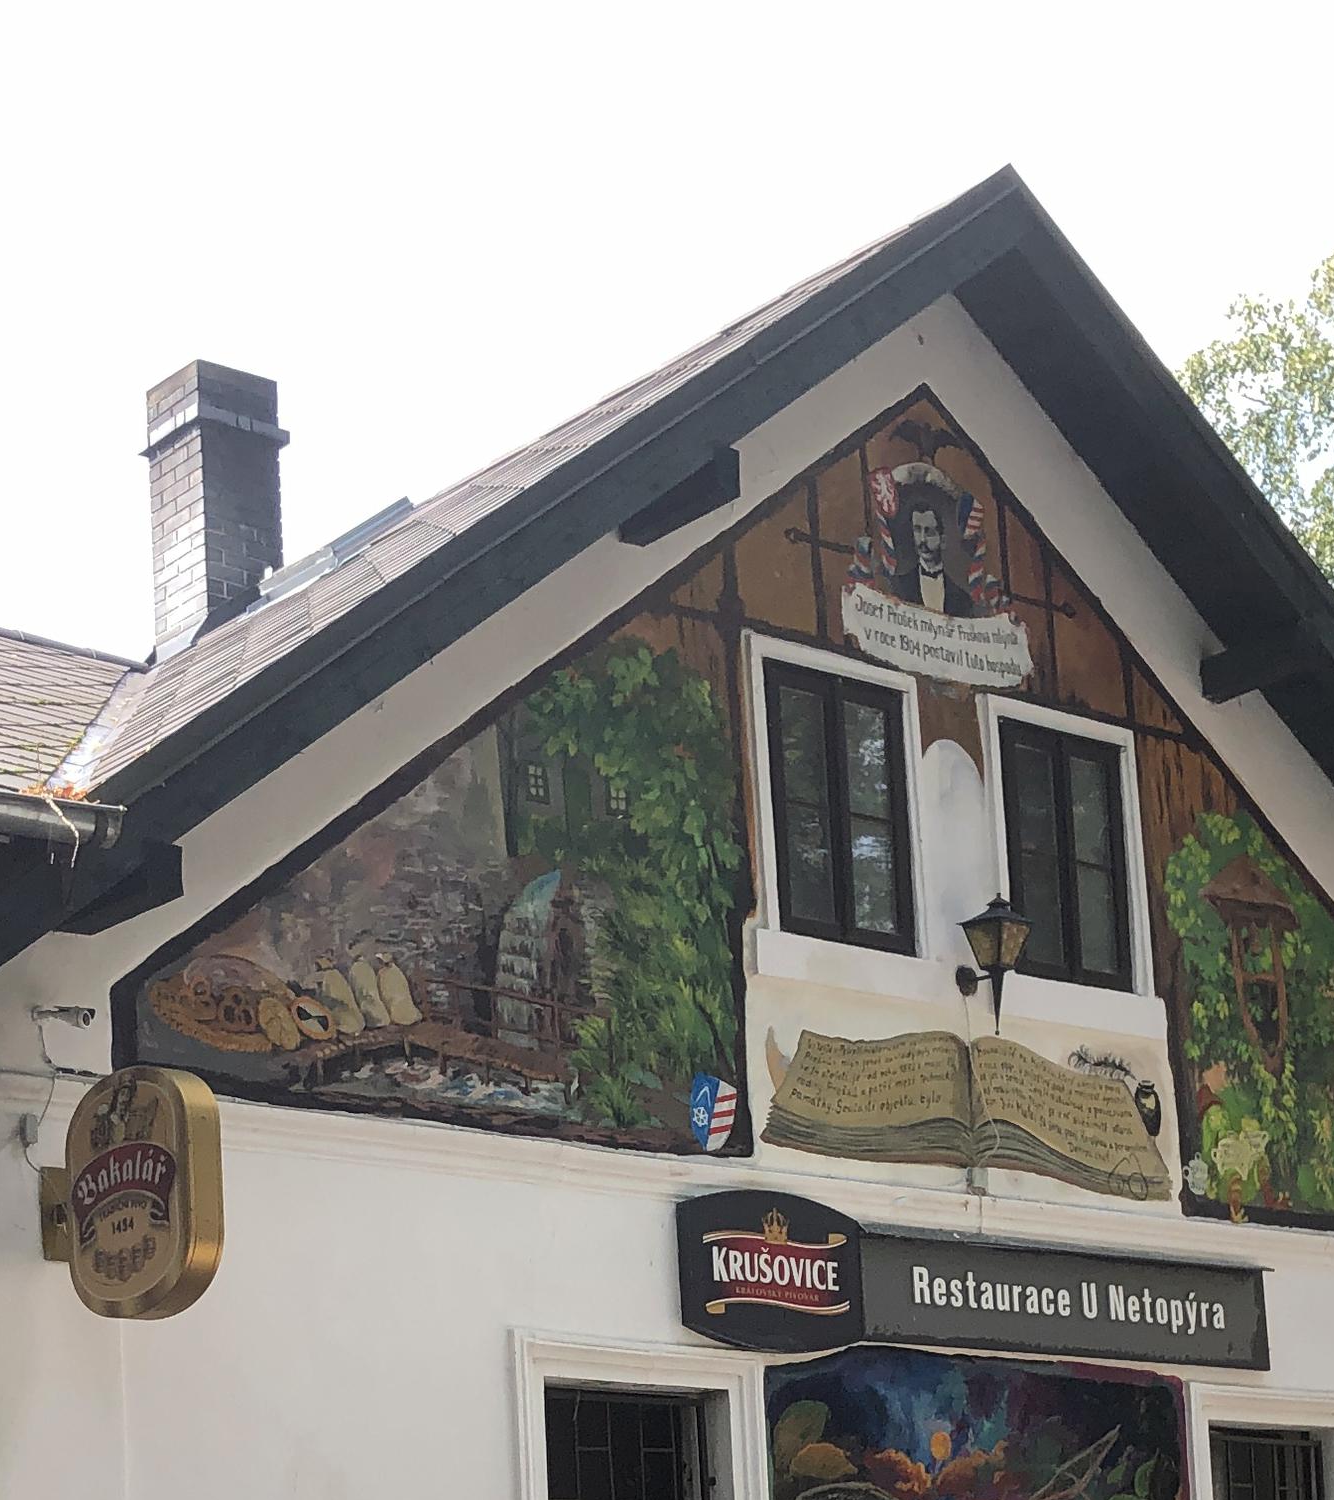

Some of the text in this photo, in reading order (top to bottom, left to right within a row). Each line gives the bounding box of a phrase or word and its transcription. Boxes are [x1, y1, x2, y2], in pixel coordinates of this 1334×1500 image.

[864, 628, 872, 640] v
[874, 630, 897, 648] roce
[899, 634, 921, 657] 1904
[923, 643, 964, 668] postavil
[77, 1148, 167, 1206] Bakalář
[711, 1245, 840, 1293] KRUŠOVICE
[912, 1266, 1227, 1336] Restaurace U Netopýra
